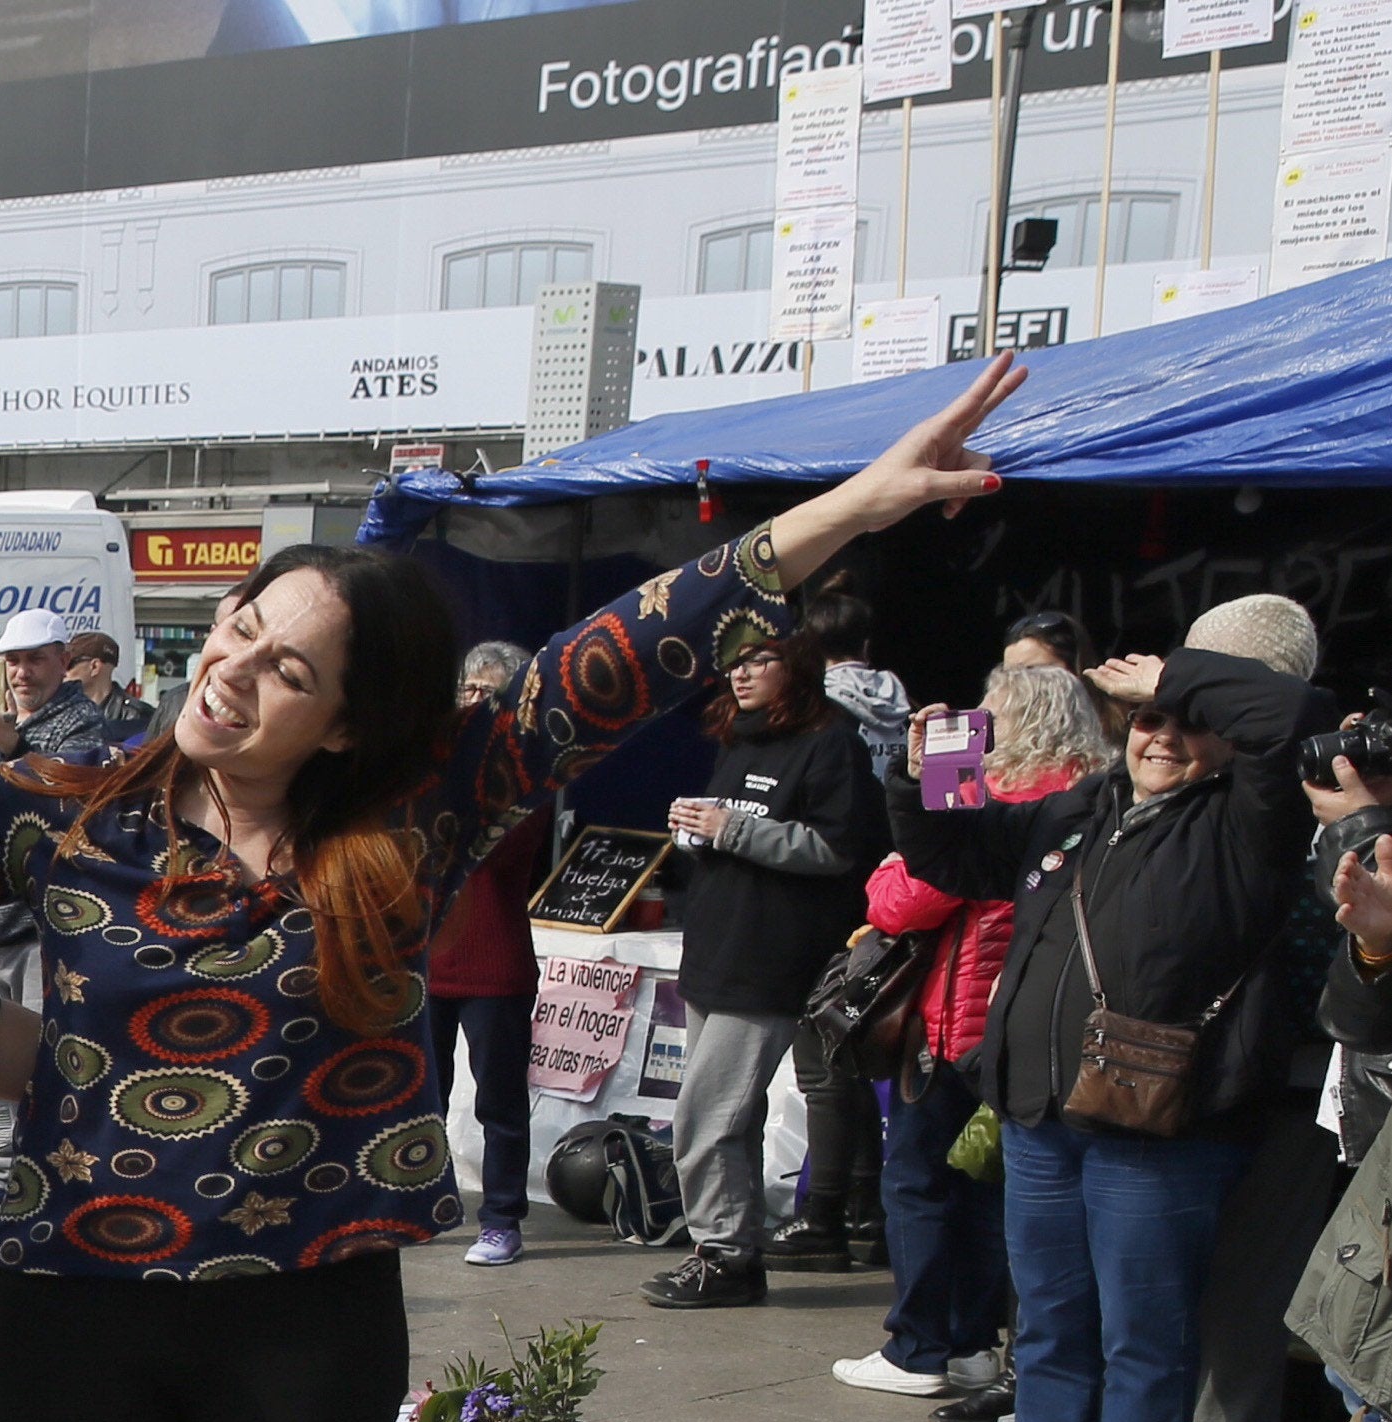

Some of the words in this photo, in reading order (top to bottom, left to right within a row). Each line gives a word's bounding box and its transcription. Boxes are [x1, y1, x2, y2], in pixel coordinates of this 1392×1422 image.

[350, 355, 439, 374] ANDAMIOS
[73, 382, 191, 411] EQUITIES
[350, 374, 439, 399] ATES
[561, 864, 627, 896] Huelga
[547, 959, 566, 983] La
[570, 959, 634, 993] violencia
[536, 1001, 557, 1022] en
[558, 1004, 576, 1027] el
[577, 1003, 625, 1042] hogar
[548, 1042, 579, 1074] otras
